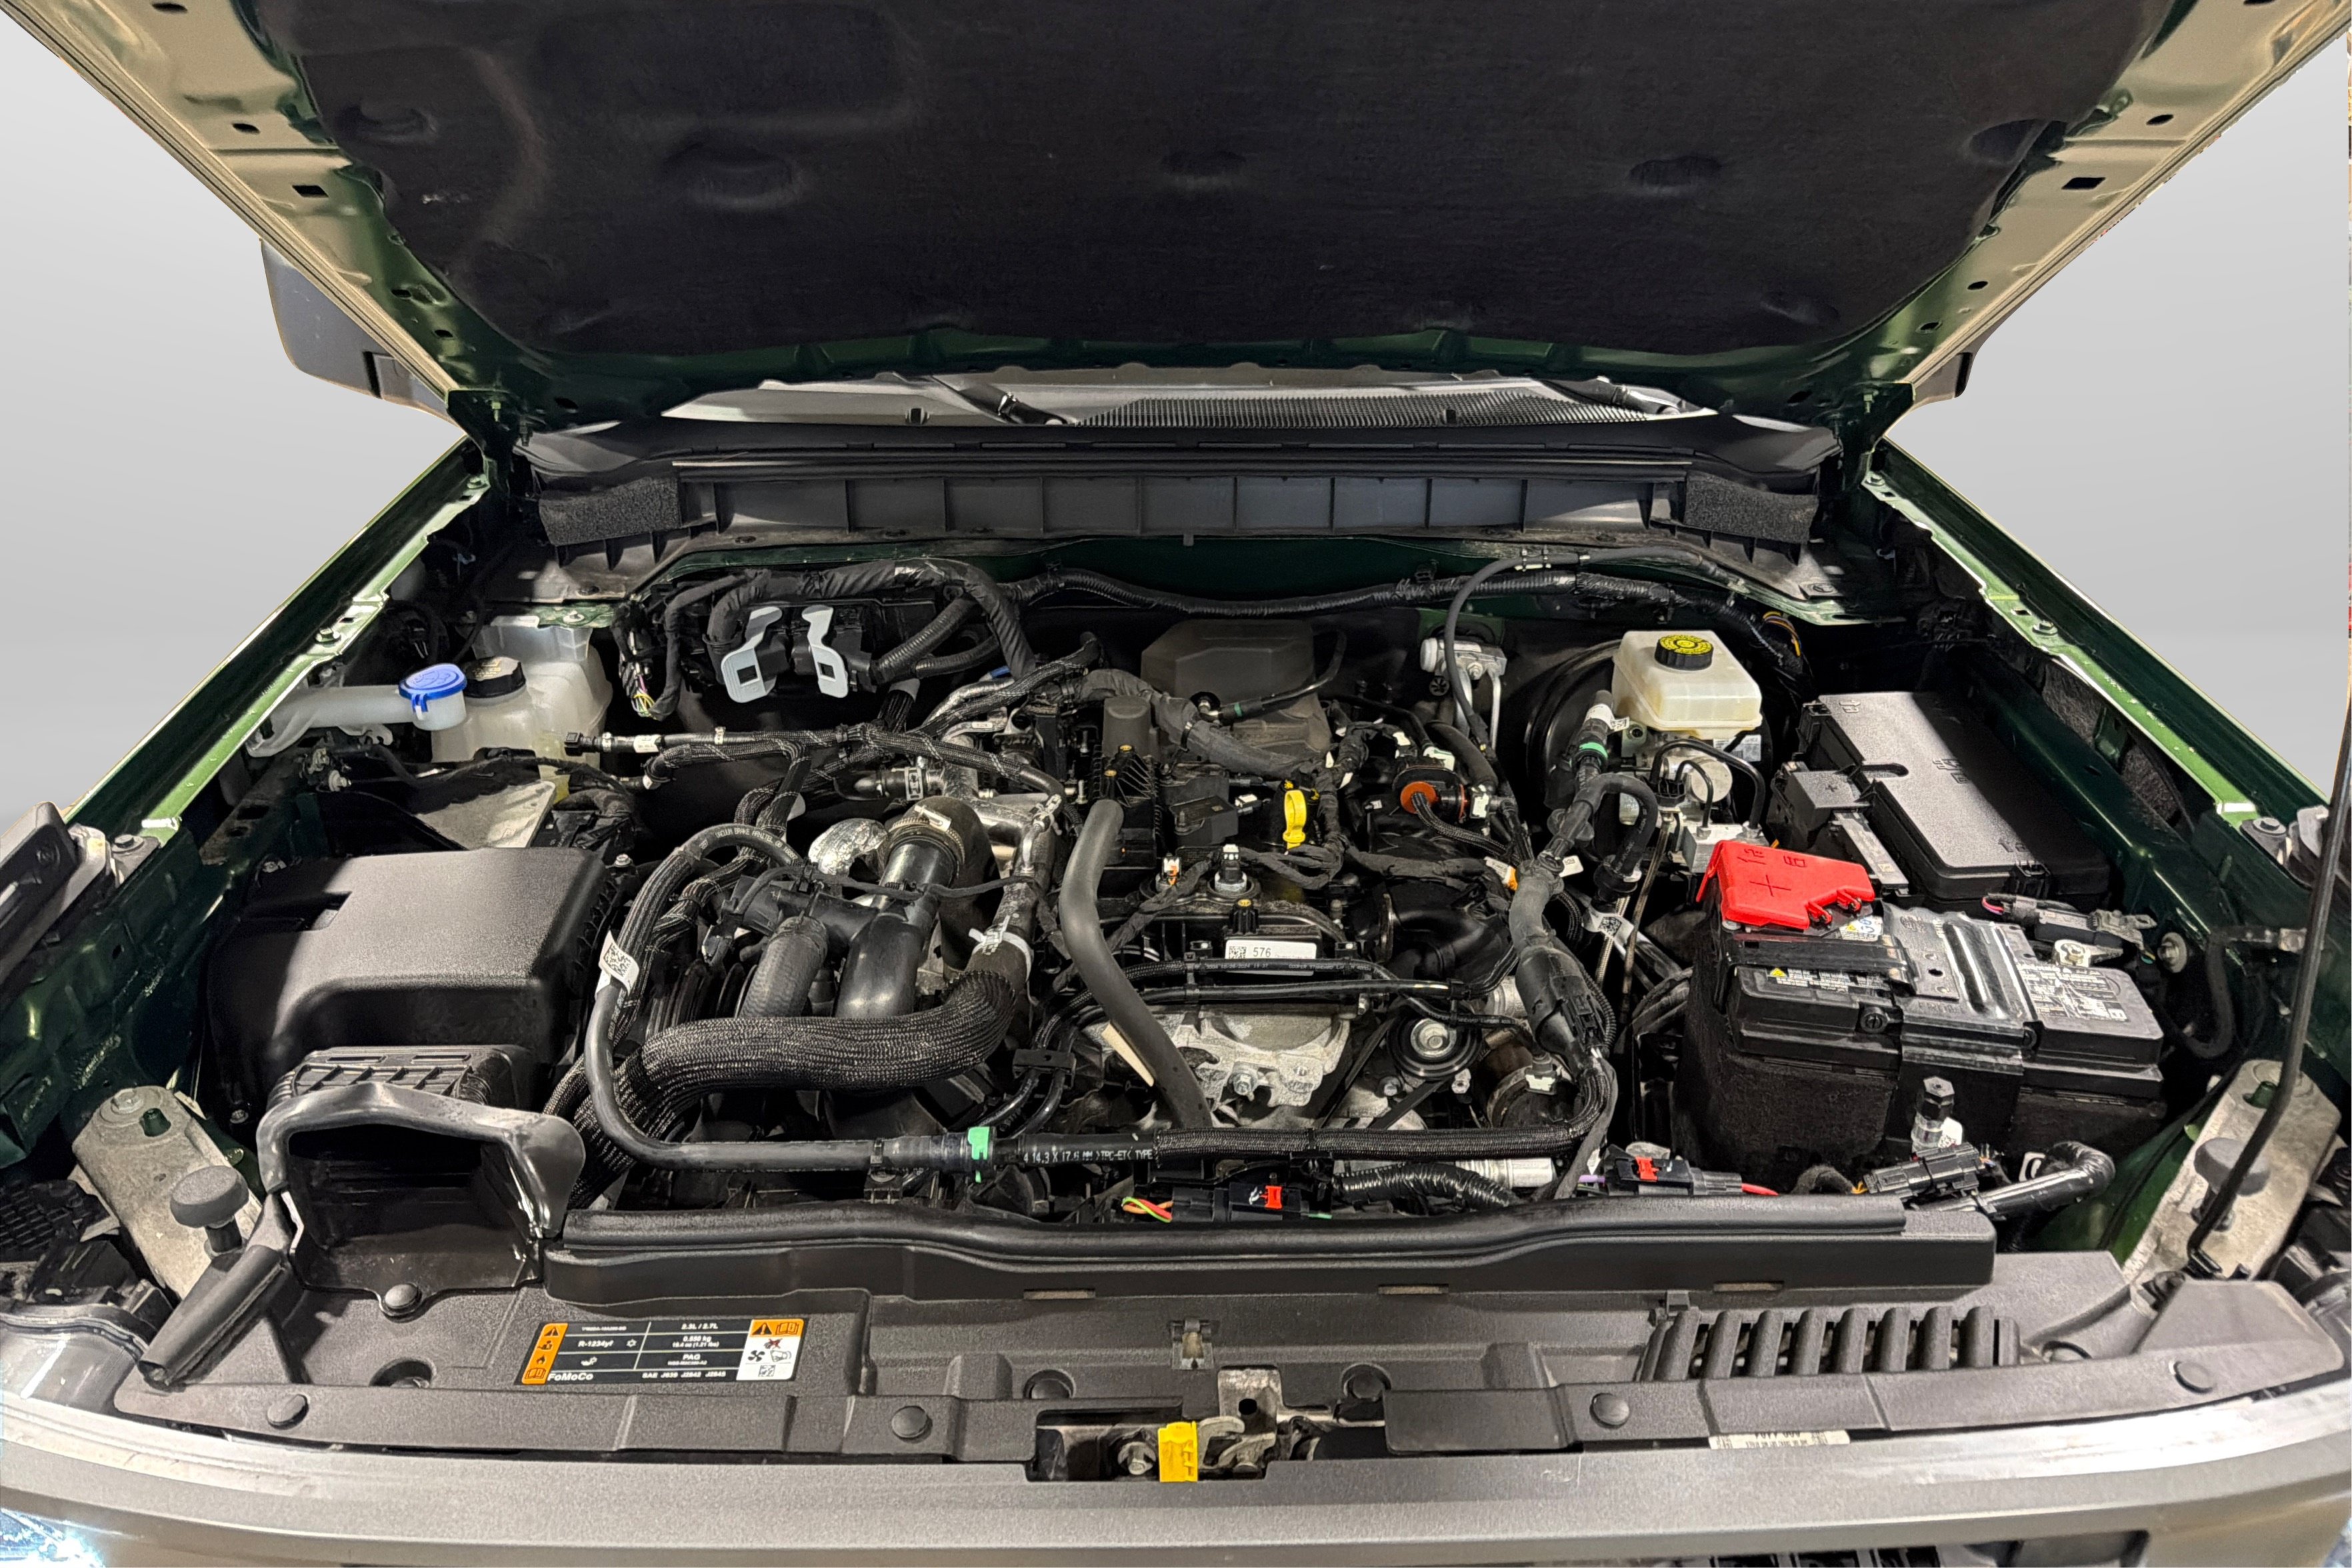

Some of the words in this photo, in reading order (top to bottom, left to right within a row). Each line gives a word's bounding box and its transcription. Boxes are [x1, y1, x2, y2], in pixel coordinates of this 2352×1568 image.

[1253, 947, 1271, 958] 576
[1032, 1151, 1050, 1164] 14.3
[1052, 1151, 1059, 1163] X
[1135, 1149, 1153, 1160] TYPE
[578, 1340, 614, 1348] R-1234yf
[547, 1372, 594, 1381] FoMoCo
